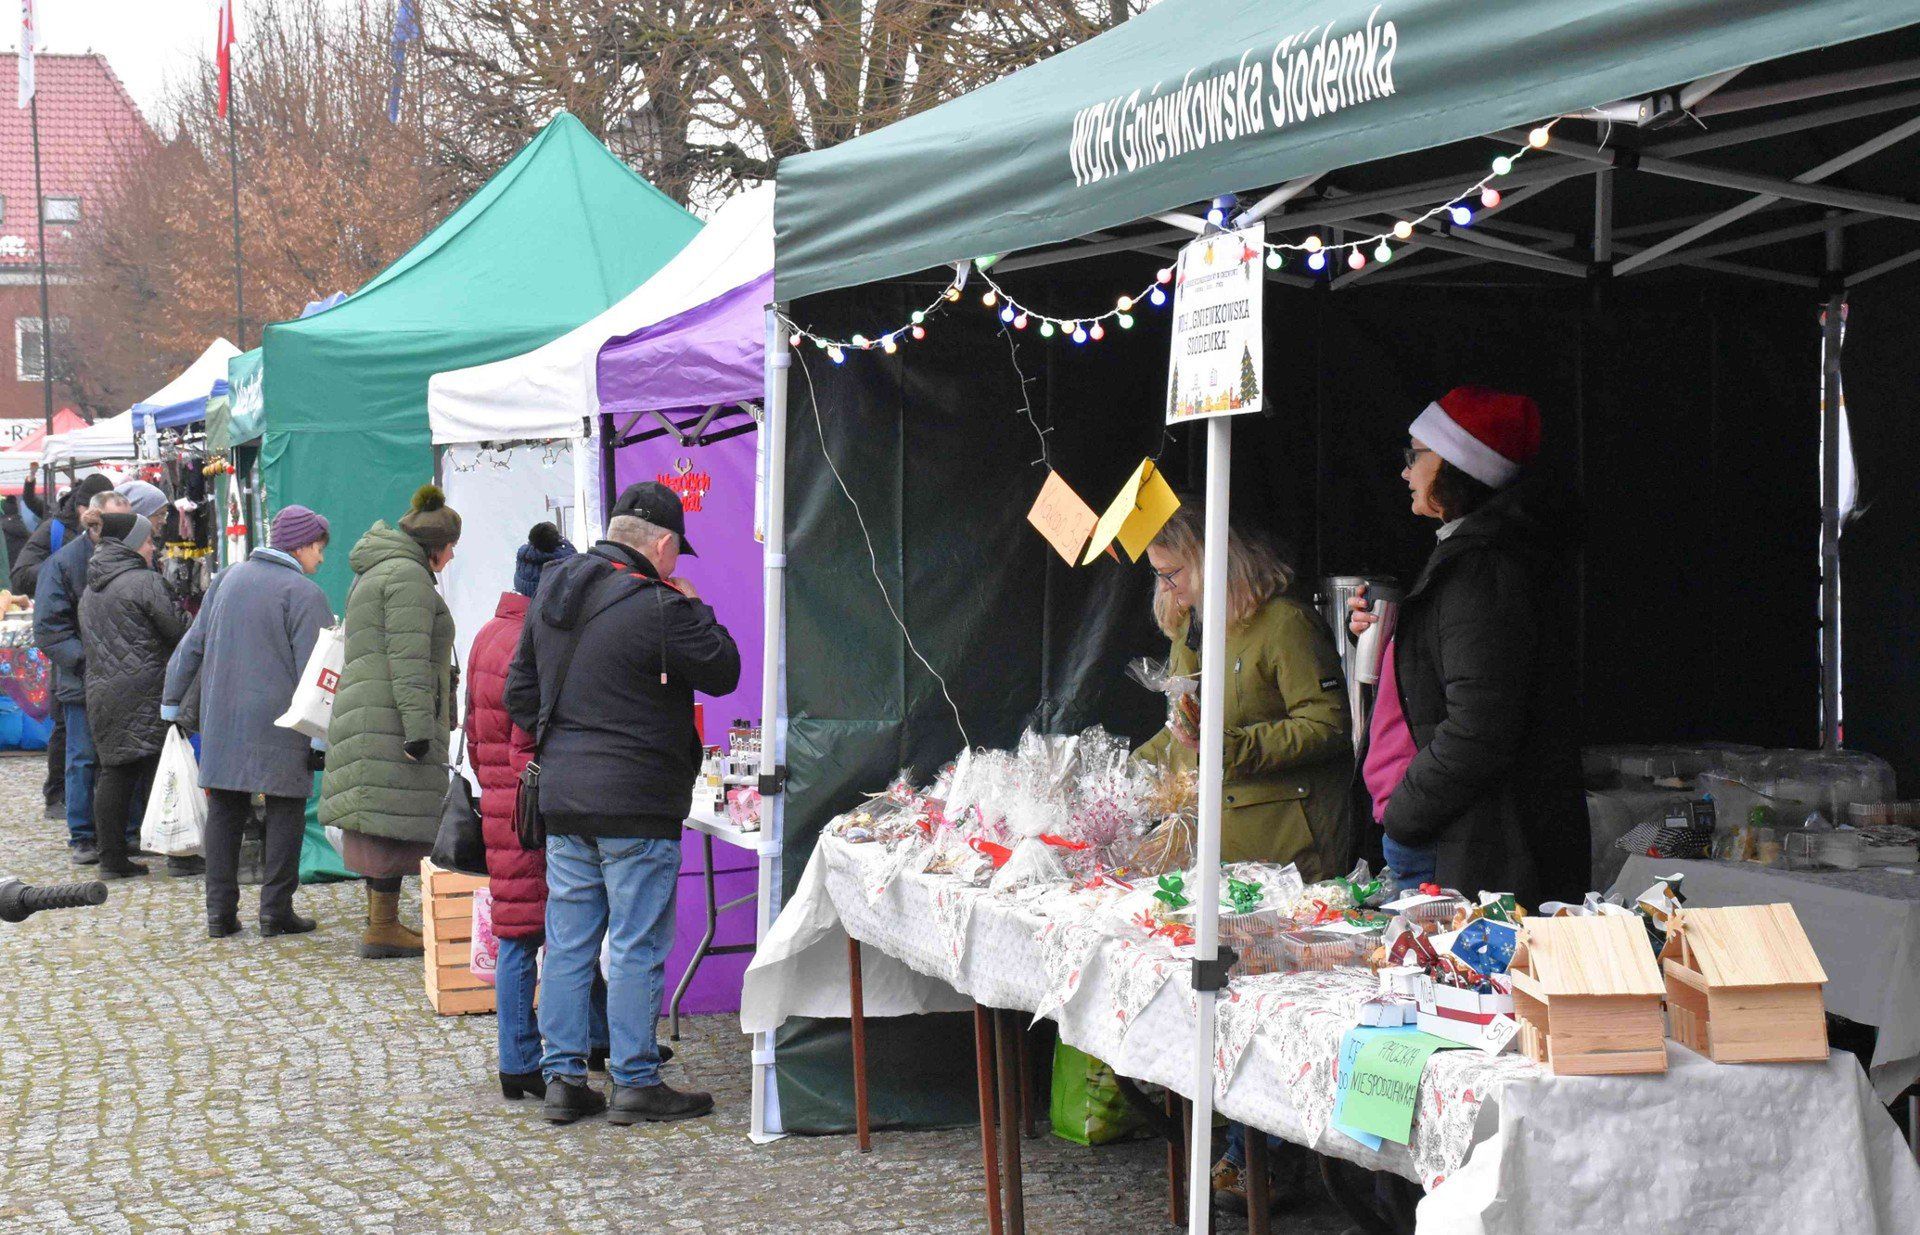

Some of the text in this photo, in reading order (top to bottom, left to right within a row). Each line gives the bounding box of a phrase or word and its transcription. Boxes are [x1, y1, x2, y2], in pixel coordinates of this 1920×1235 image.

[1070, 4, 1397, 187] WDH Gniewkowska Siódemka
